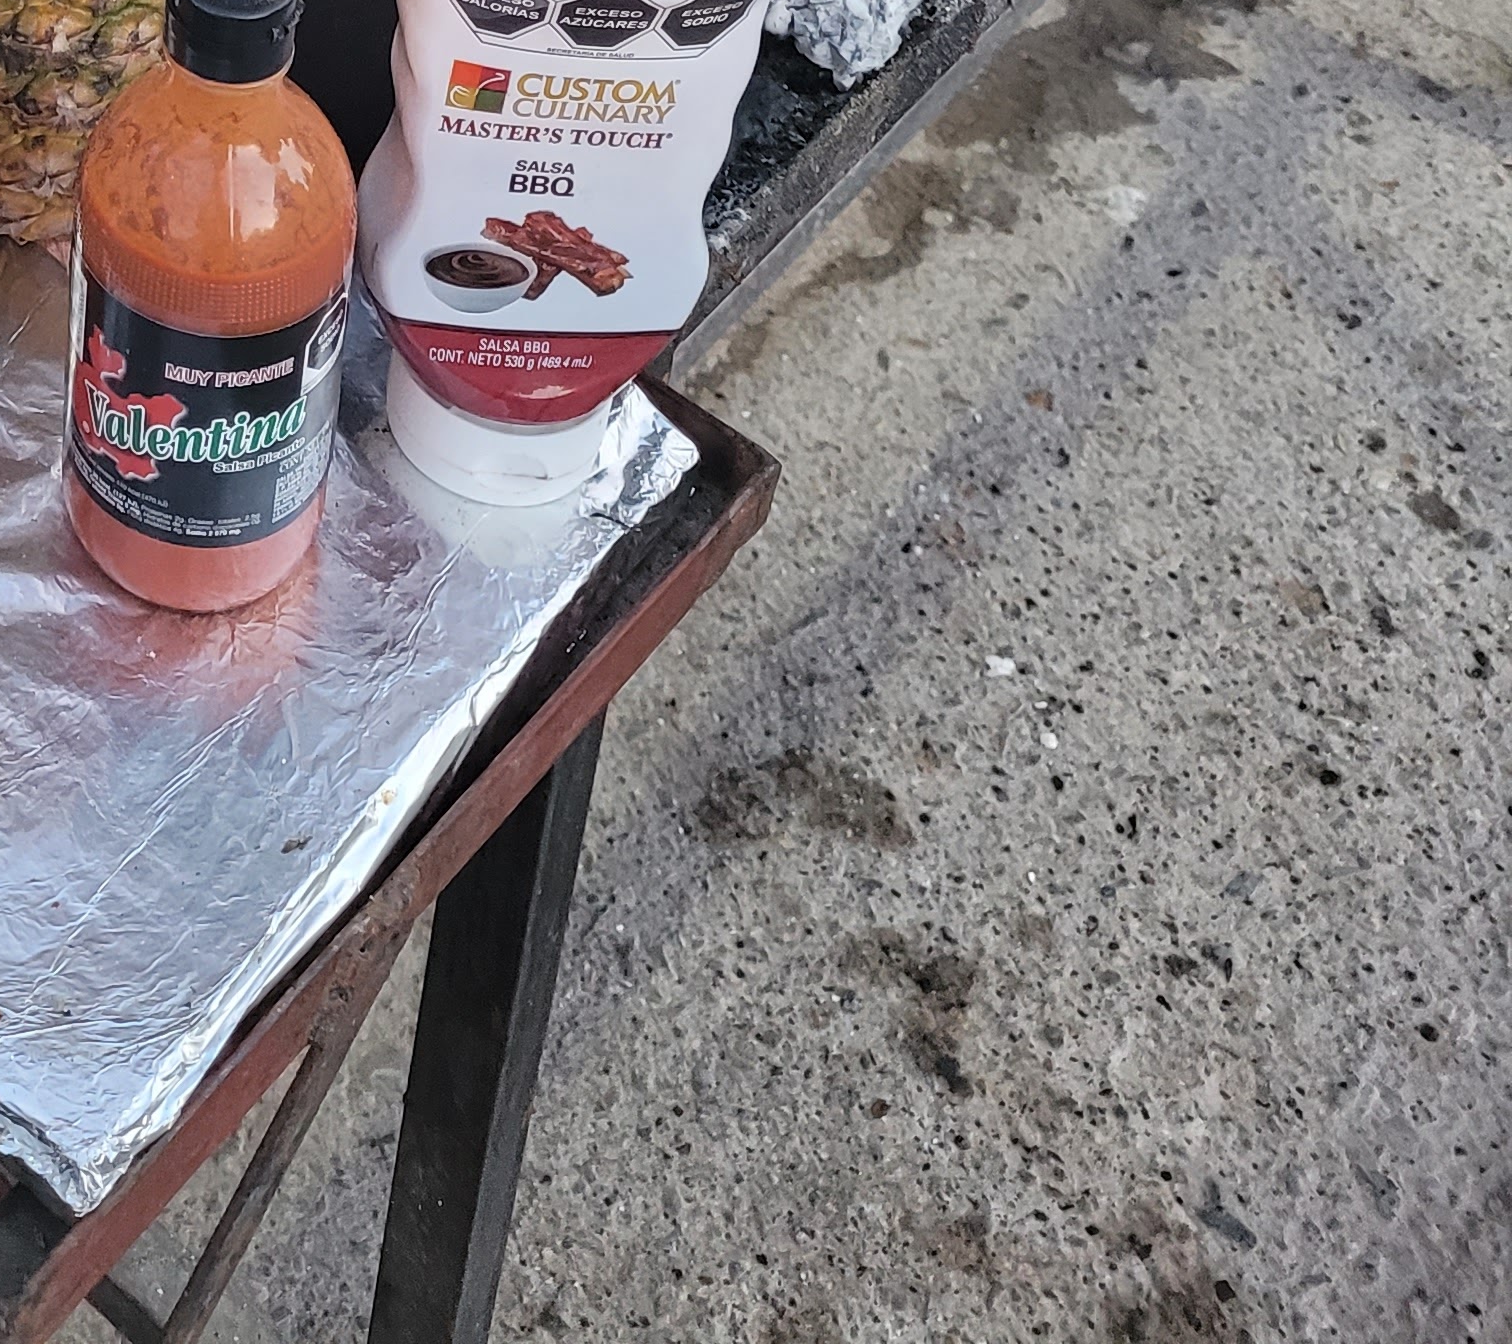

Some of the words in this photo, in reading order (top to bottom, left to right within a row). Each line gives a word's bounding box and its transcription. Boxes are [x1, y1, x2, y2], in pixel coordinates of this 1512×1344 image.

[574, 6, 644, 19] EXCESO
[680, 0, 744, 17] EXCESO
[559, 15, 649, 30] AZÚCARES
[681, 12, 729, 28] SODIO
[516, 73, 677, 104] CUSTOM
[511, 97, 675, 125] CULINARY
[438, 115, 564, 145] MASTER'S
[568, 129, 667, 149] TOUCH
[515, 160, 576, 175] SALSA
[508, 173, 575, 197] BBQ
[478, 337, 520, 353] SALSA
[523, 341, 551, 353] BBQ
[429, 347, 465, 363] CONT.
[467, 352, 502, 367] NETO
[504, 354, 525, 368] 530
[526, 359, 535, 371] g
[164, 362, 213, 387] MUY
[214, 357, 295, 388] PICANTE
[83, 378, 308, 463] Valentina
[212, 460, 254, 474] Salsa
